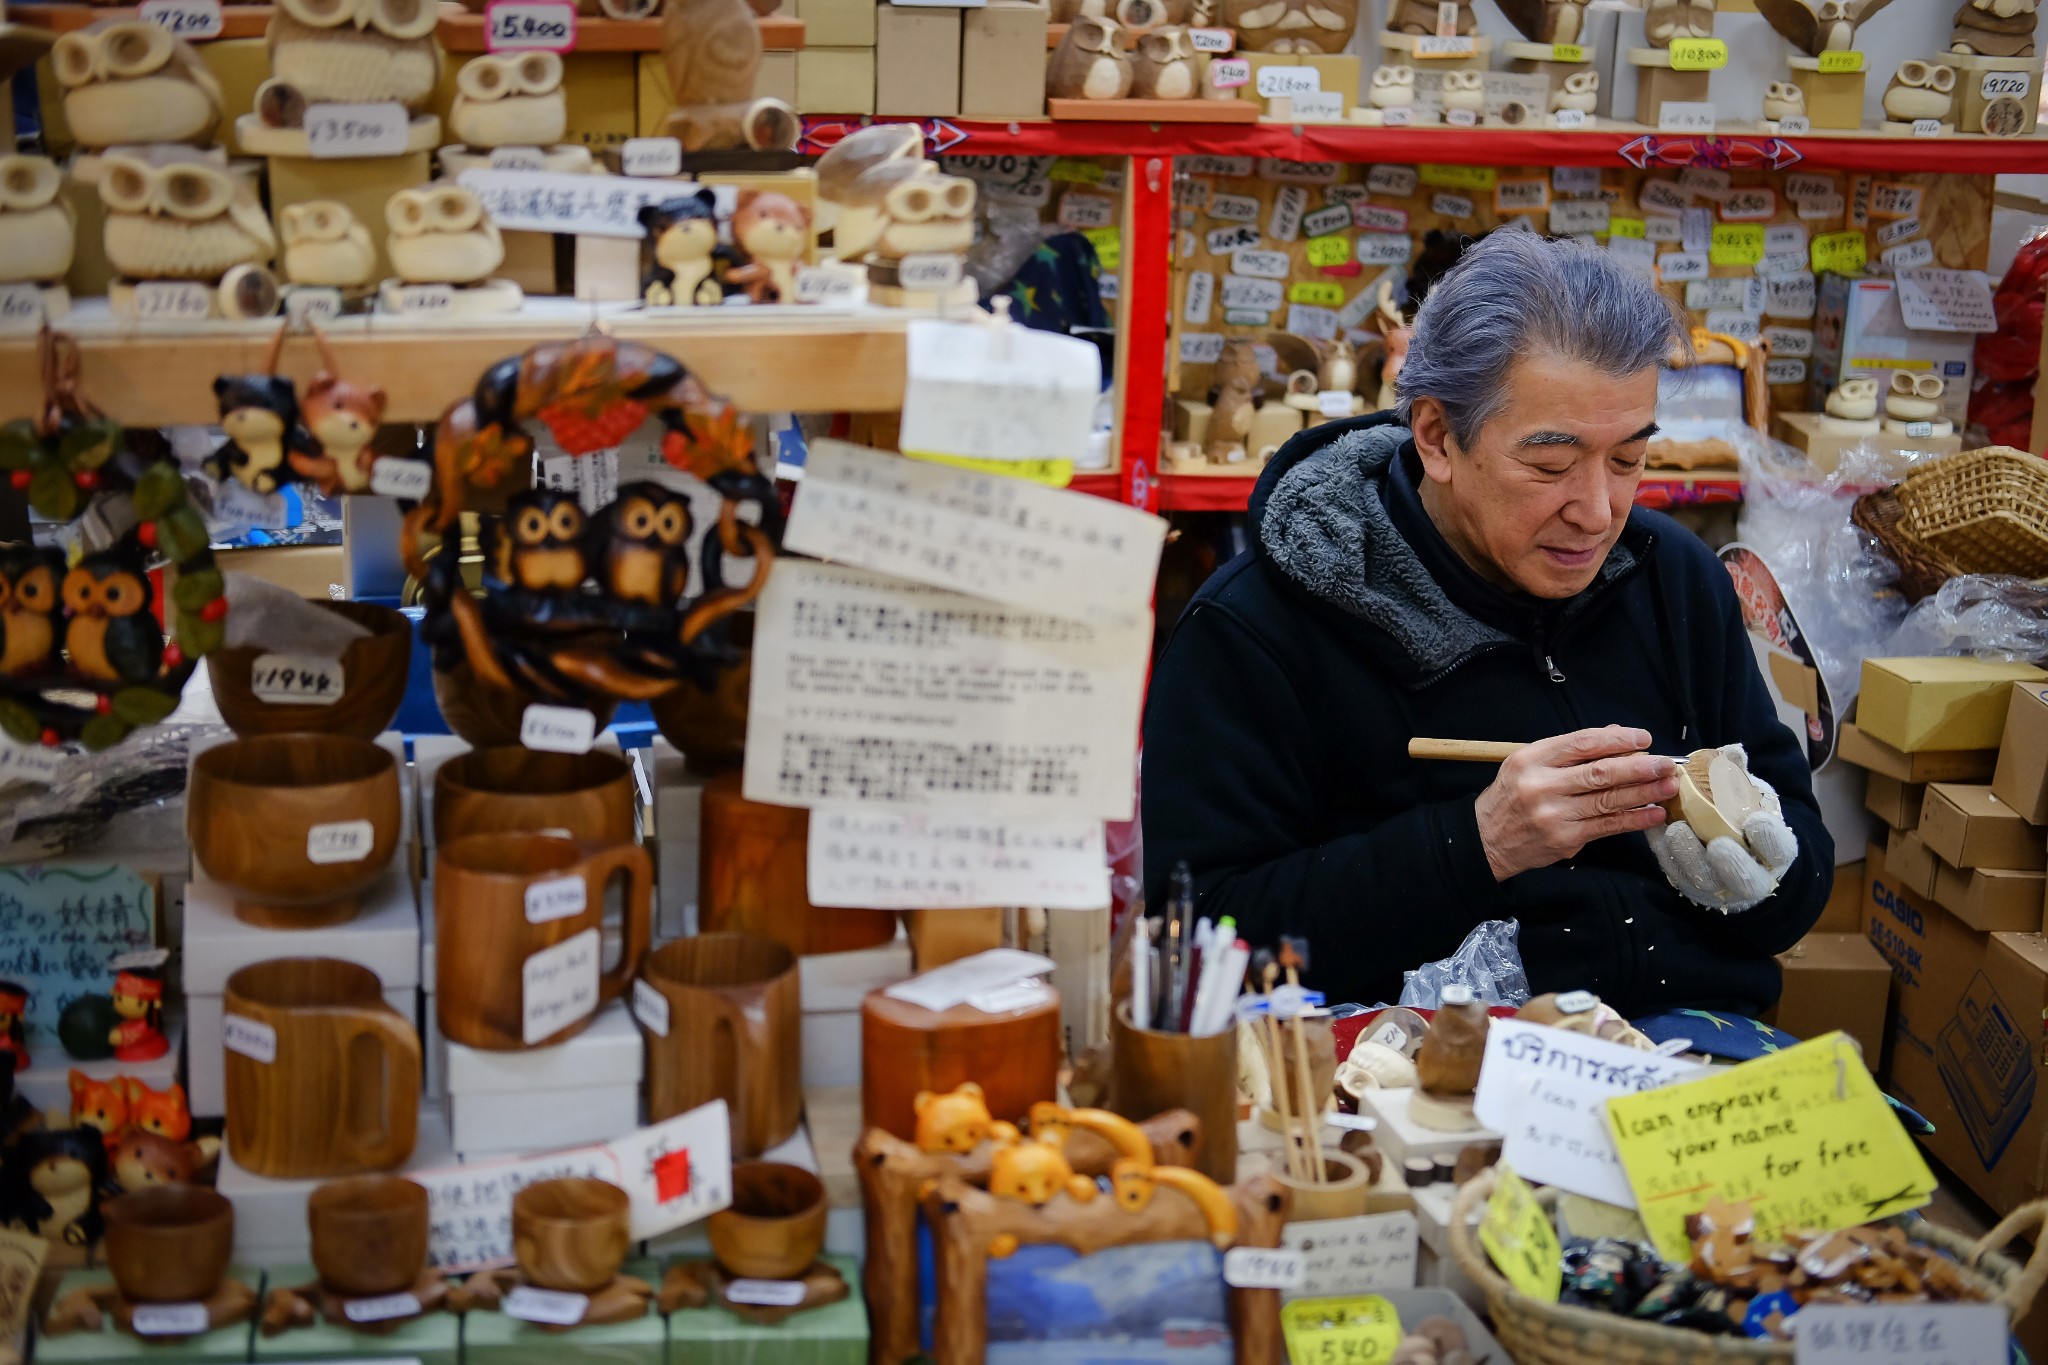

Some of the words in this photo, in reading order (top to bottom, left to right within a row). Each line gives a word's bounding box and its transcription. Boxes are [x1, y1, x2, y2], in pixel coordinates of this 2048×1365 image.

[1872, 879, 1925, 937] CASIO
[1611, 1109, 1627, 1140] I
[1631, 1113, 1673, 1137] can
[1685, 1086, 1783, 1125] engrave
[1667, 1138, 1718, 1166] your
[1731, 1119, 1798, 1146] name
[1764, 1154, 1803, 1180] for
[1818, 1140, 1871, 1167] free
